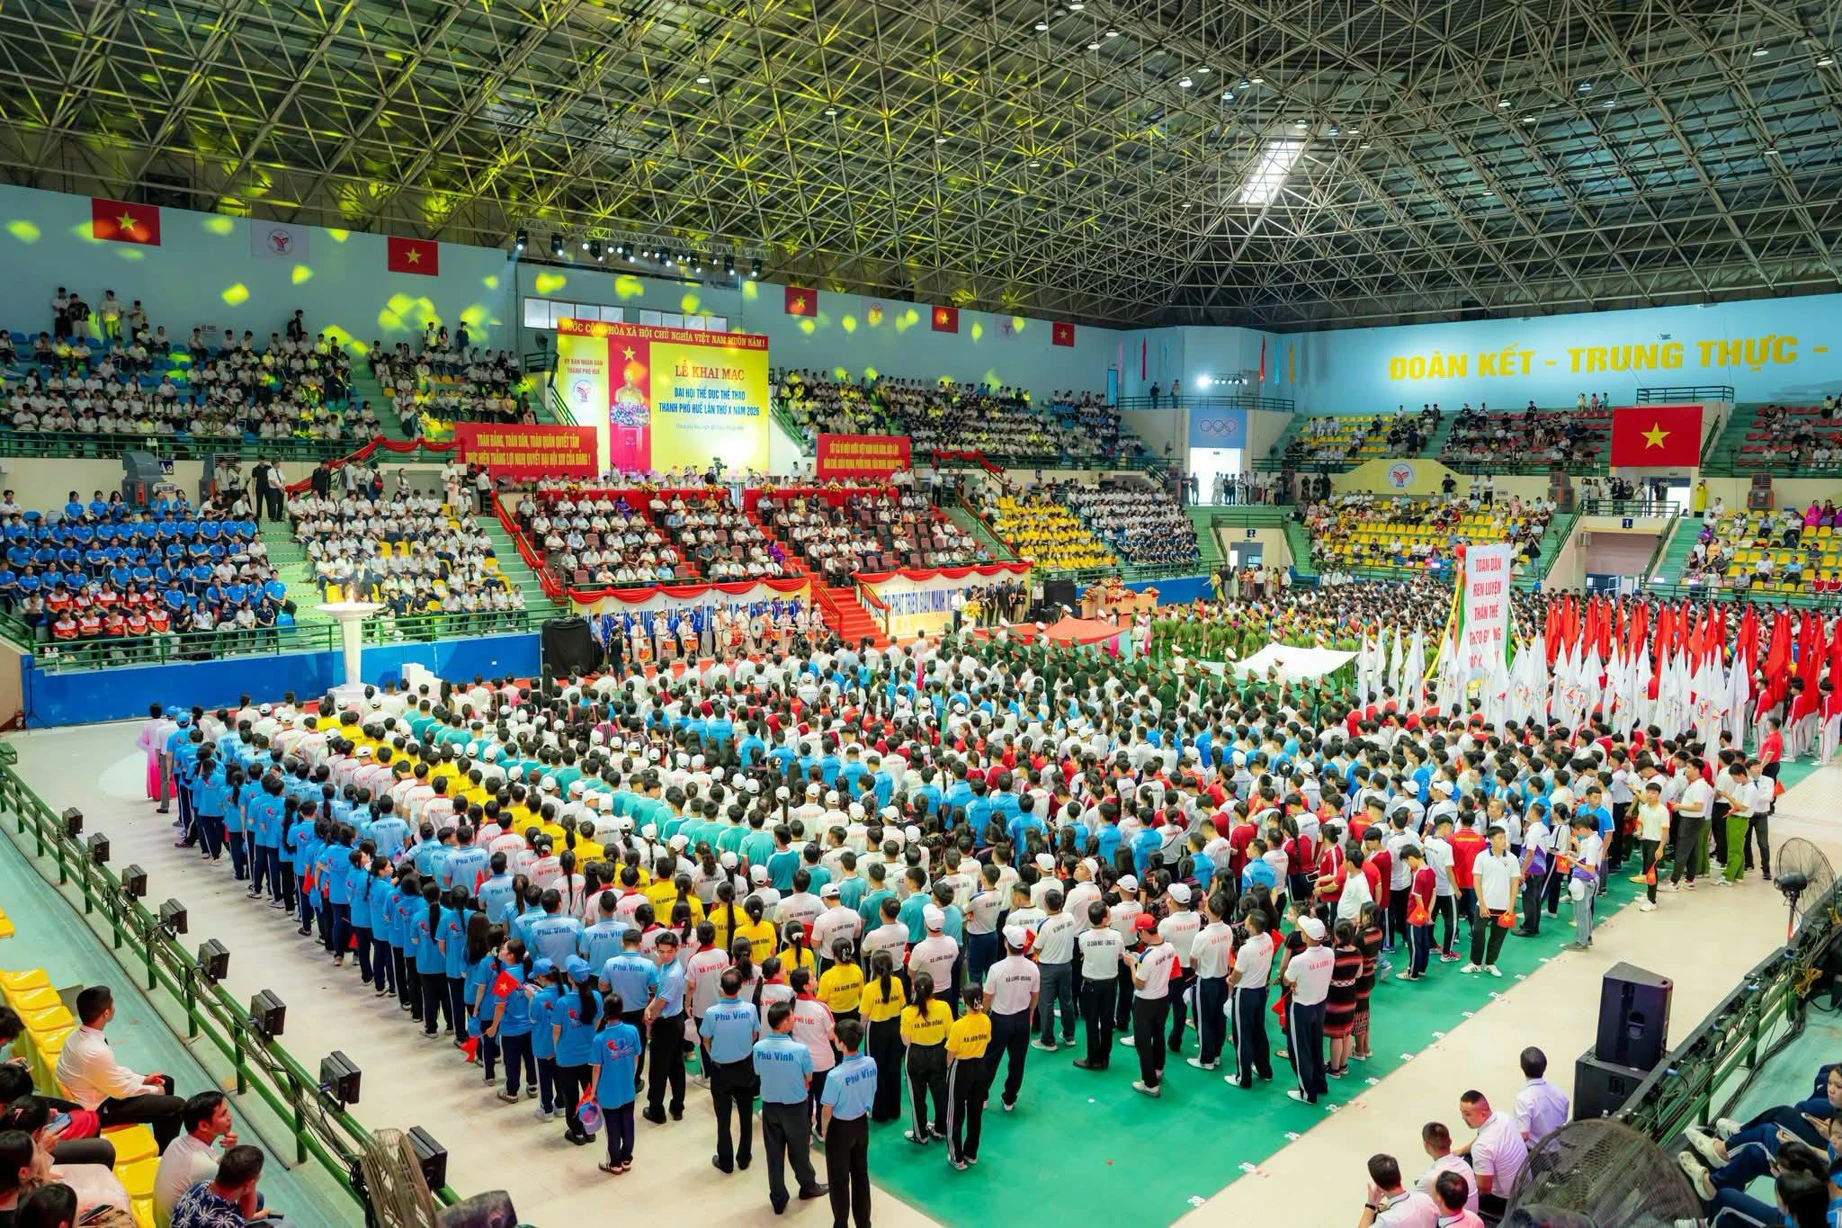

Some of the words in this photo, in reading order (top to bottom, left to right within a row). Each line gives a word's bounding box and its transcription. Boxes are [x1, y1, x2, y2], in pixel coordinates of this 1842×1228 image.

[608, 324, 625, 336] HÒA
[626, 325, 637, 337] XÃ
[639, 327, 652, 340] HỘI
[654, 328, 669, 339] CHỦ
[671, 331, 693, 342] NGHĨA
[694, 332, 710, 344] VIỆT
[712, 336, 726, 344] NAM
[1389, 350, 1468, 380] ĐOÀN
[1477, 342, 1535, 377] KẾT
[1568, 342, 1684, 373] TRUNG
[1697, 334, 1799, 372] THỰC
[692, 366, 719, 379] KHAI
[722, 368, 745, 382] MẠC
[732, 390, 746, 401] THAO
[733, 1010, 751, 1020] Vinh
[757, 1050, 771, 1060] Phú
[775, 1052, 794, 1061] Vinh
[845, 1073, 859, 1087] Phú
[862, 1066, 877, 1080] Vinh
